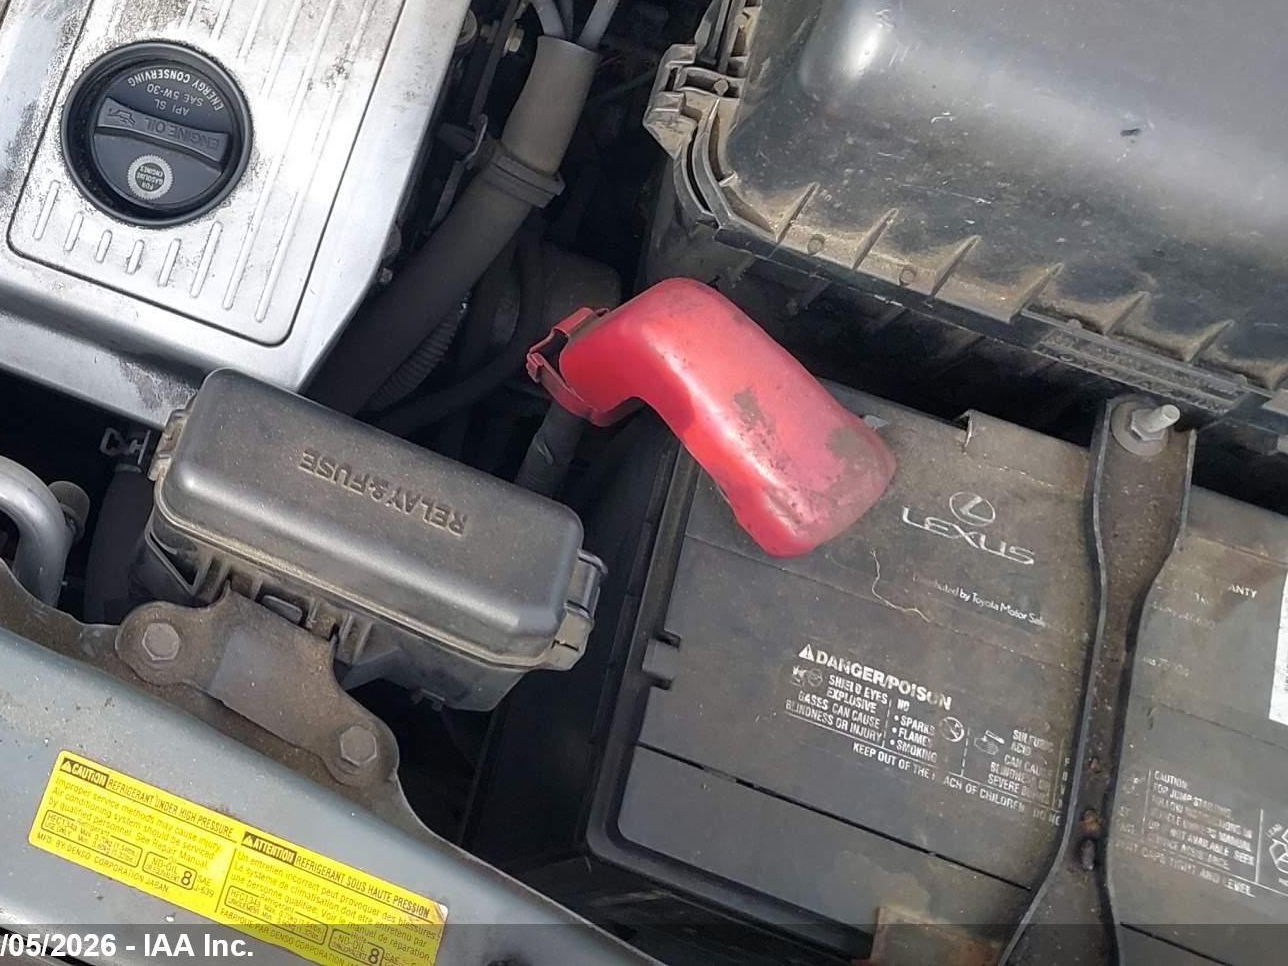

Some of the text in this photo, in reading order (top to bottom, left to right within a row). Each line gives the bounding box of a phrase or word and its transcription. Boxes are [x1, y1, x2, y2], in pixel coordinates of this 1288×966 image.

[127, 69, 225, 112] ENERGY CONSERVING
[146, 83, 204, 108] SAE 5W-30
[153, 98, 190, 117] API SL
[144, 116, 220, 150] ENGINE OIL
[298, 449, 468, 538] RELAY&FUSE
[902, 505, 1036, 565] LEXUS
[815, 650, 952, 711] DANGER/POISON
[828, 674, 861, 694] SHIELD
[797, 691, 881, 729] GASES CAN CAUSE
[826, 687, 877, 713] EXPLOSIVE
[784, 699, 882, 742] BLINDNESS OR INJURY
[852, 742, 1024, 812] KEEP OUT OF THE OF CHILDREN
[64, 793, 112, 818] conditioning
[70, 764, 232, 836] CAUTION REFRIGERANT UNDER HIGH PRESSURE
[67, 845, 90, 859] DENSO
[94, 856, 144, 881] CORPORATION
[179, 869, 194, 887] 8
[253, 838, 429, 917] ATTENTION REFRIGERANT SOUS HAUTE PRESSION
[255, 923, 268, 934] PAR
[270, 929, 293, 944] DENSO
[294, 940, 344, 966] CORPORATION
[366, 946, 382, 965] 8
